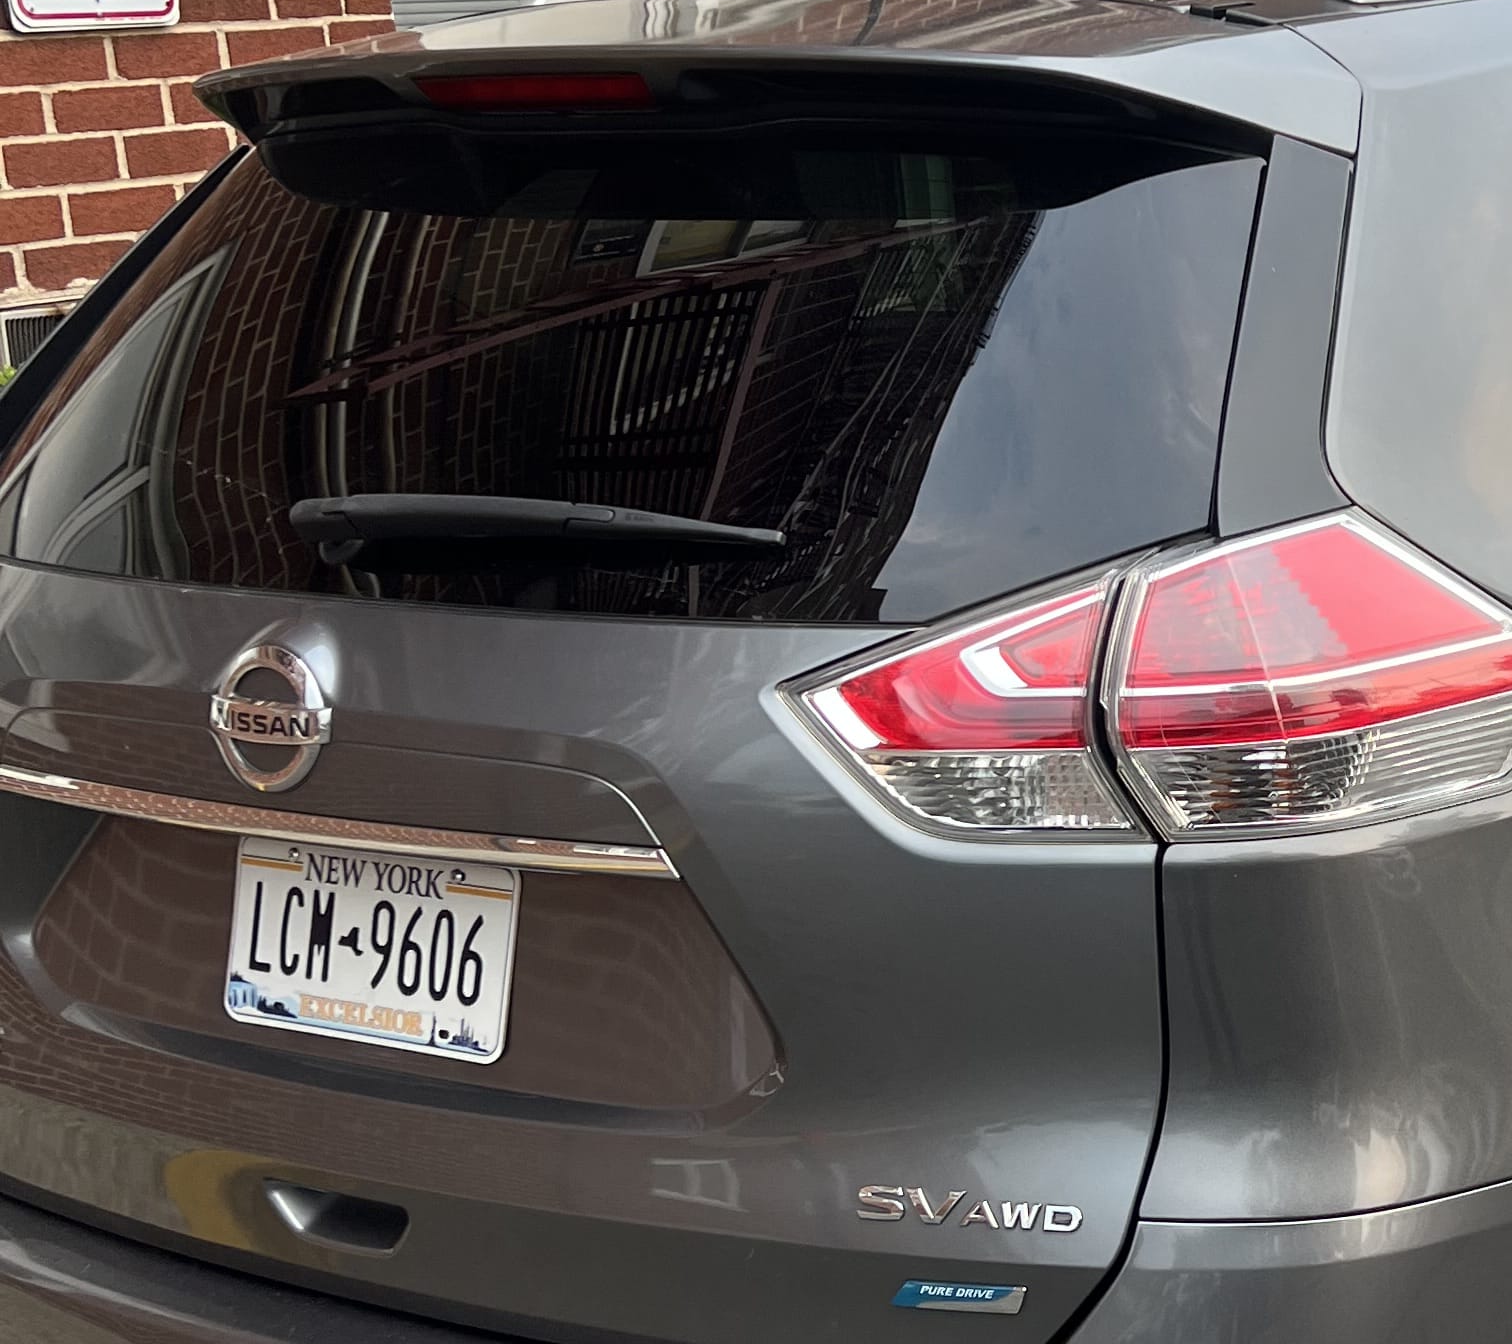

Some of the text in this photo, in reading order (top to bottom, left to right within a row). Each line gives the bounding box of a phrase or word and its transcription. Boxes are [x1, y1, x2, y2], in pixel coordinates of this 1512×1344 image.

[214, 707, 310, 737] NISSAN
[305, 853, 444, 900] NEW YORK
[301, 994, 423, 1036] EXCELSIOR
[920, 1285, 994, 1300] PURE DRIVE
